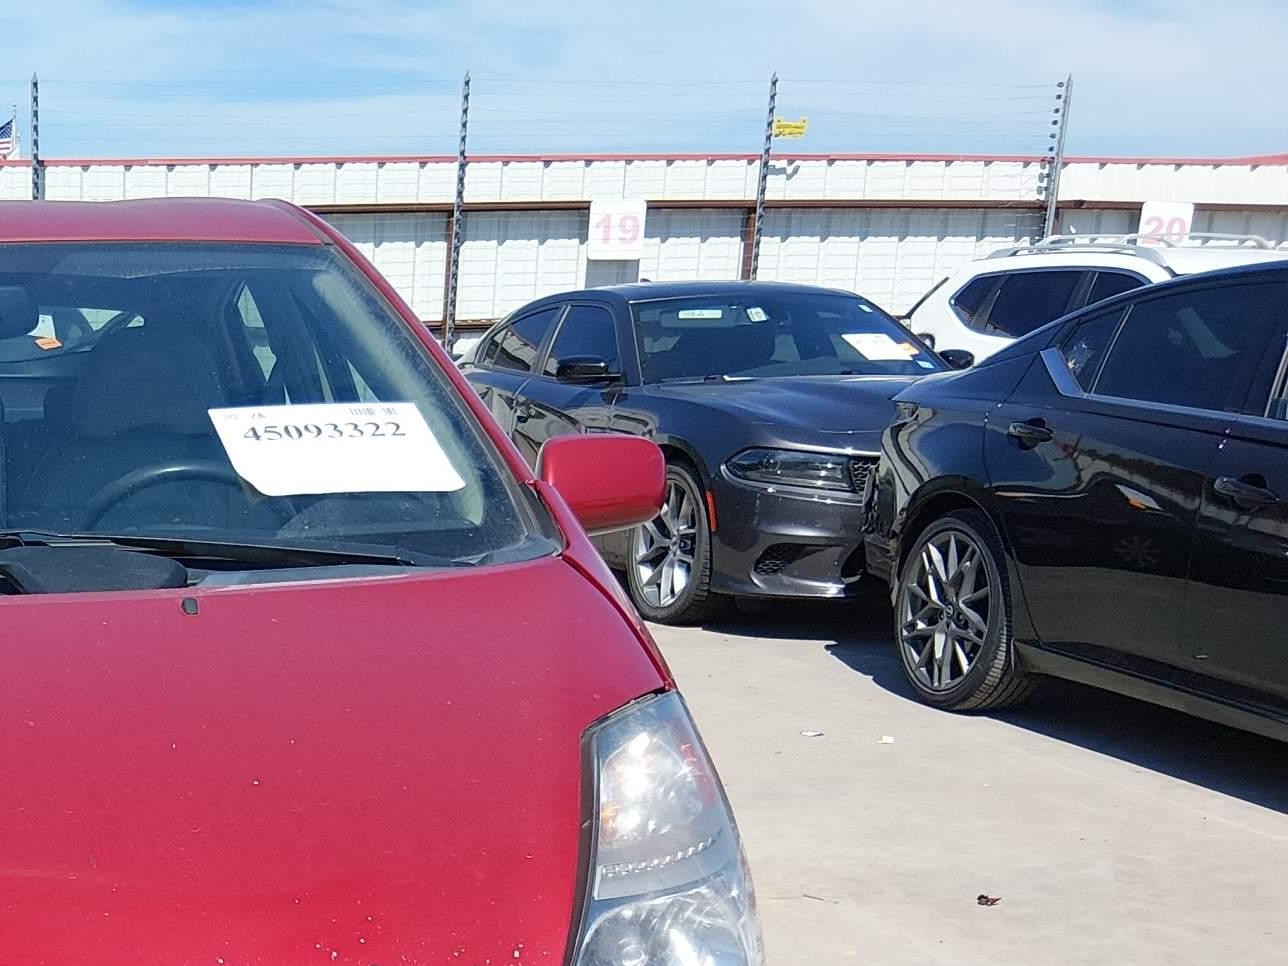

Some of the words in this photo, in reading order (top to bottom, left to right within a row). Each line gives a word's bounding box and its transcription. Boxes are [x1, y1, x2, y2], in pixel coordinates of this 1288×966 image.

[595, 214, 640, 244] 19
[1142, 216, 1186, 245] 20
[243, 421, 406, 441] 45093322
